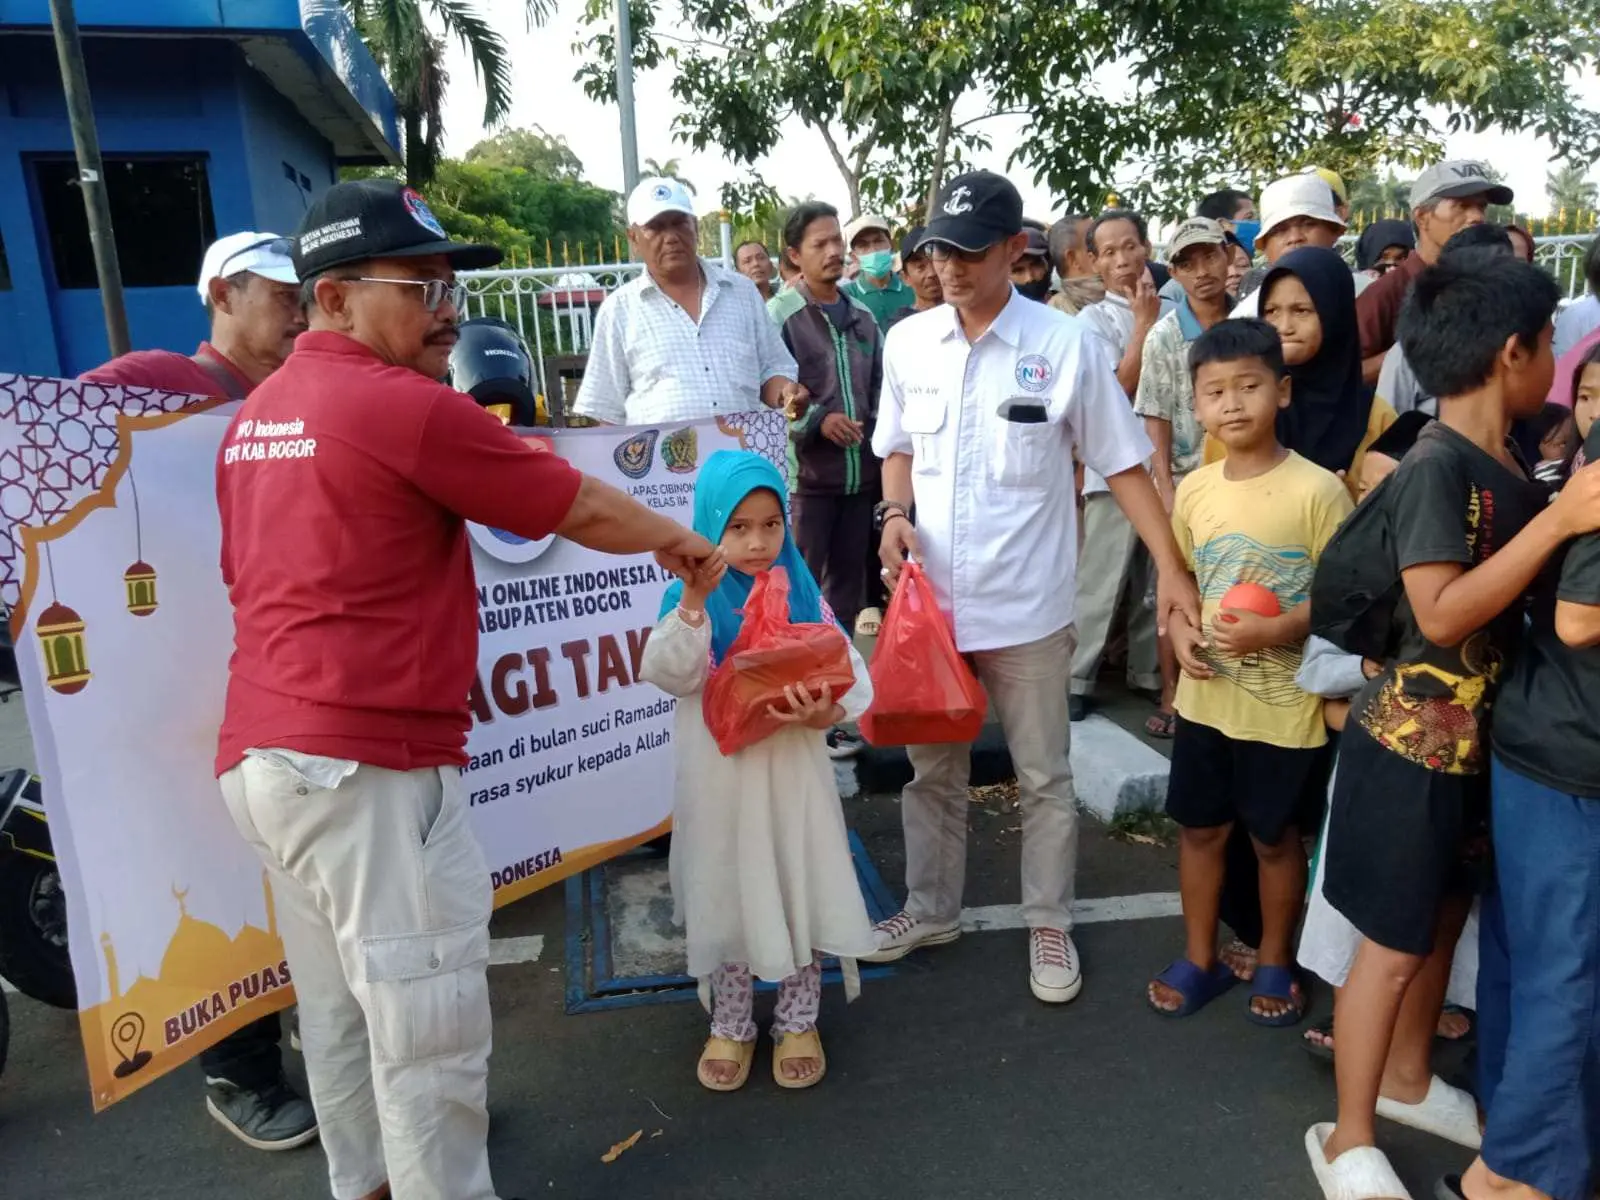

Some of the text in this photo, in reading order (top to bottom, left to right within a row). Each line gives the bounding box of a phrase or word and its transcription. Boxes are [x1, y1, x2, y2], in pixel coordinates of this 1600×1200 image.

[253, 416, 305, 437] Indonesia
[268, 438, 316, 459] BOGOR
[627, 481, 697, 497] LAPAS CIBINON
[647, 496, 676, 508] KELAS
[491, 576, 561, 606] ONLINE
[564, 563, 657, 596] INDONESIA
[478, 589, 633, 635] ABUPATEN BOGOR
[467, 626, 654, 724] AGI TAK
[508, 736, 526, 760] di
[529, 726, 578, 754] bulan
[580, 712, 611, 739] suci
[468, 727, 671, 807] rasa syukur kepada Allah
[489, 846, 563, 892] DONESIA
[163, 959, 293, 1046] BUKA PUAS
